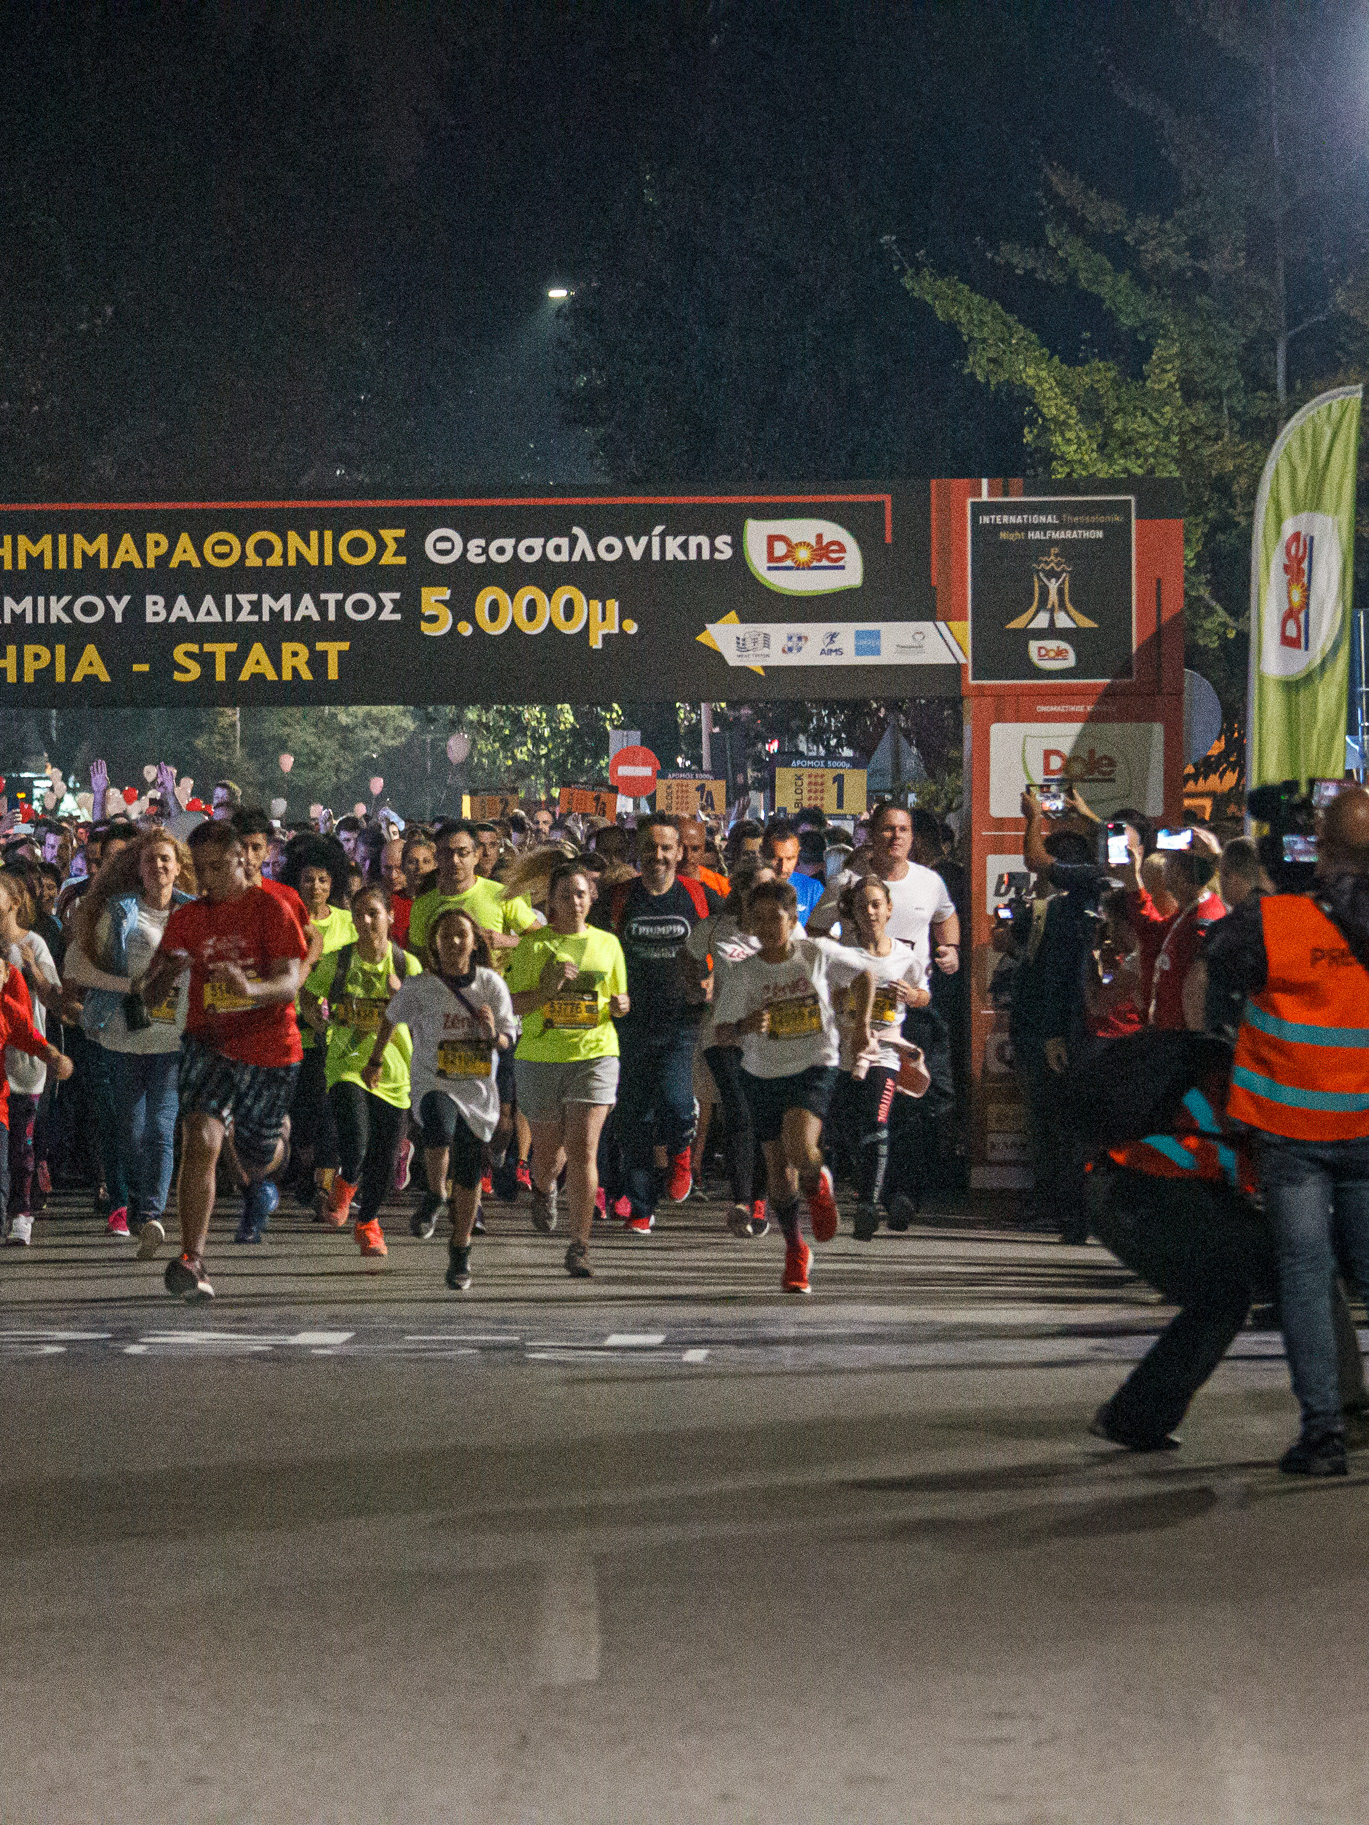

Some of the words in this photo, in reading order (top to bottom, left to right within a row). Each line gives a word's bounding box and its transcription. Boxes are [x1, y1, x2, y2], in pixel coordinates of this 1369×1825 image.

[979, 514, 1059, 524] INTERNATIONAL
[1028, 530, 1103, 540] HALFMARATHON
[424, 526, 733, 565] Θεσσαλονίκης
[766, 533, 847, 567] Dole
[1280, 531, 1308, 650] Dole
[145, 592, 401, 623] ΒΑΔΙΣΜΑΤΟΣ
[420, 585, 638, 648] 5.000μ.
[173, 641, 350, 682] START
[820, 648, 843, 656] AIMS
[1037, 645, 1069, 658] Dole
[1043, 749, 1117, 777] Dole
[794, 773, 803, 809] BLOCK
[832, 773, 844, 809] 1
